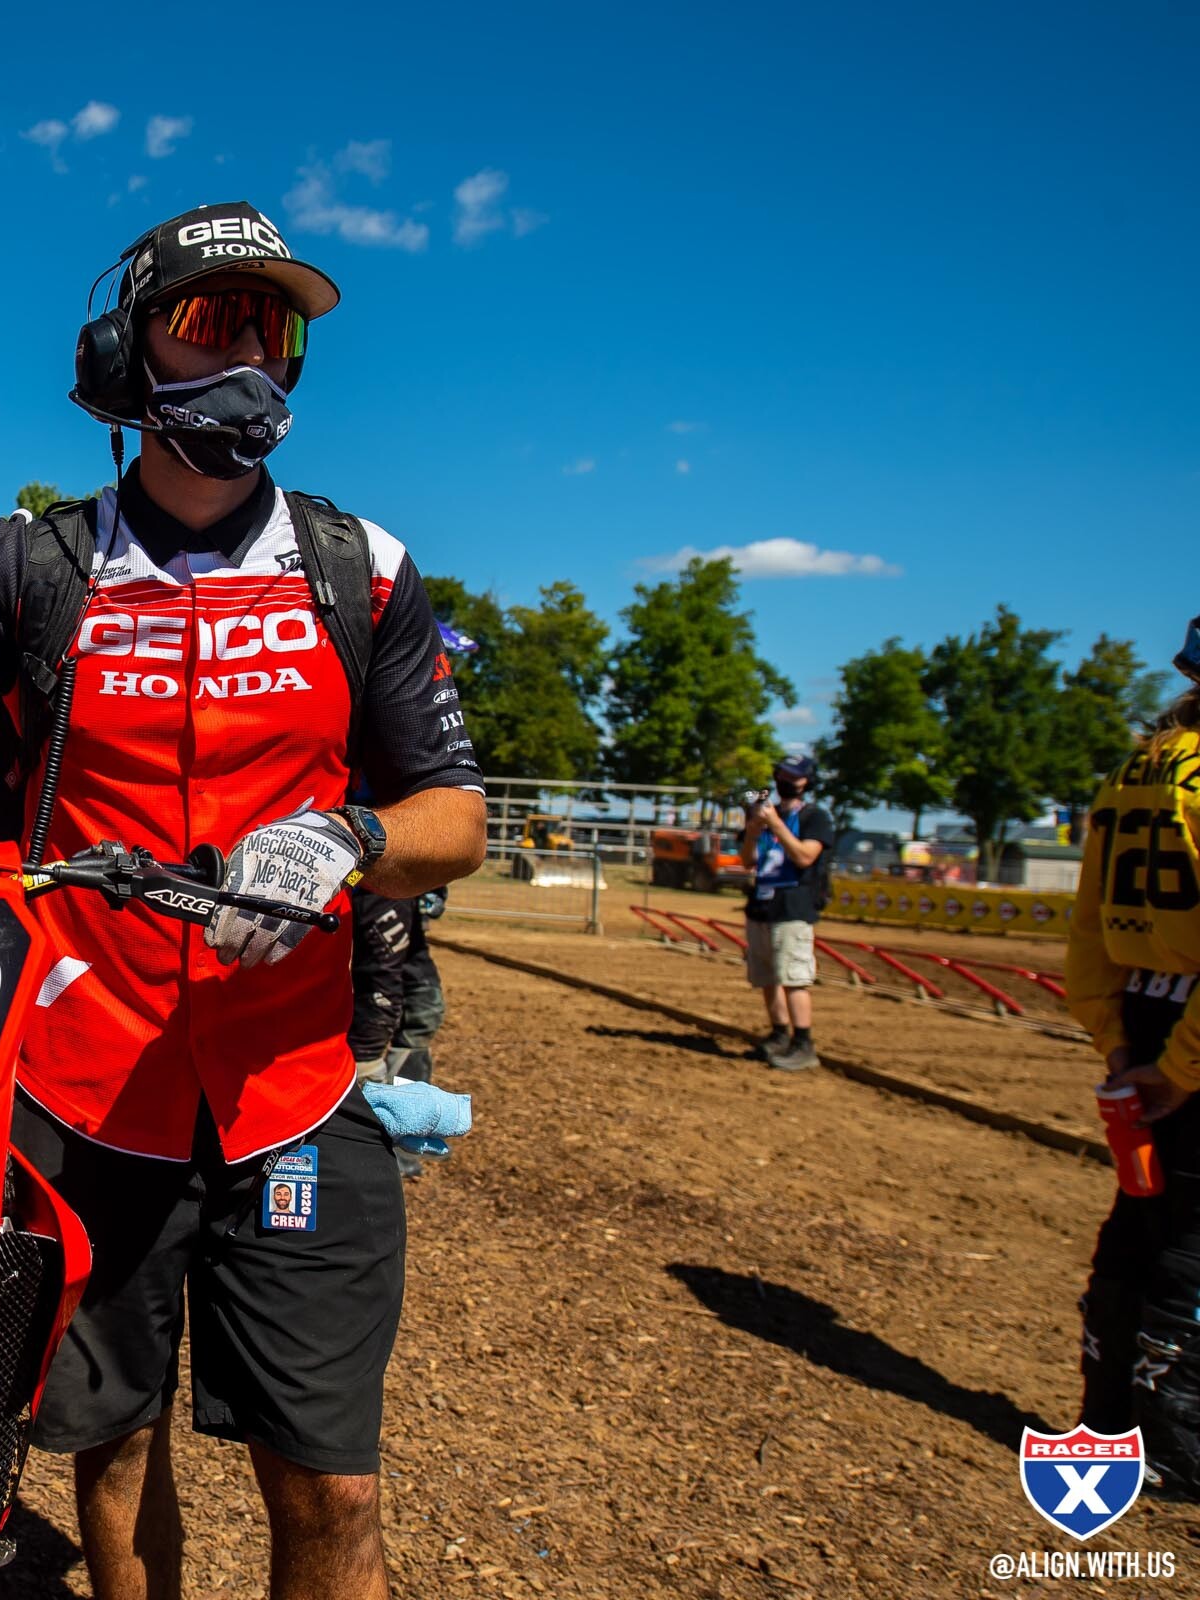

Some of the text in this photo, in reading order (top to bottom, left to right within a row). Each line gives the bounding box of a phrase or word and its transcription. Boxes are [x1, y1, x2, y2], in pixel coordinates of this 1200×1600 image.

[178, 217, 292, 259] GEICO
[78, 609, 318, 661] GEICO
[99, 667, 312, 699] HONDA
[246, 834, 318, 872] Mechanix
[265, 828, 336, 862] Mechanix
[144, 889, 215, 915] ARC
[271, 907, 312, 921] ARC
[301, 1183, 312, 1215] 2020
[271, 1215, 307, 1228] CREW
